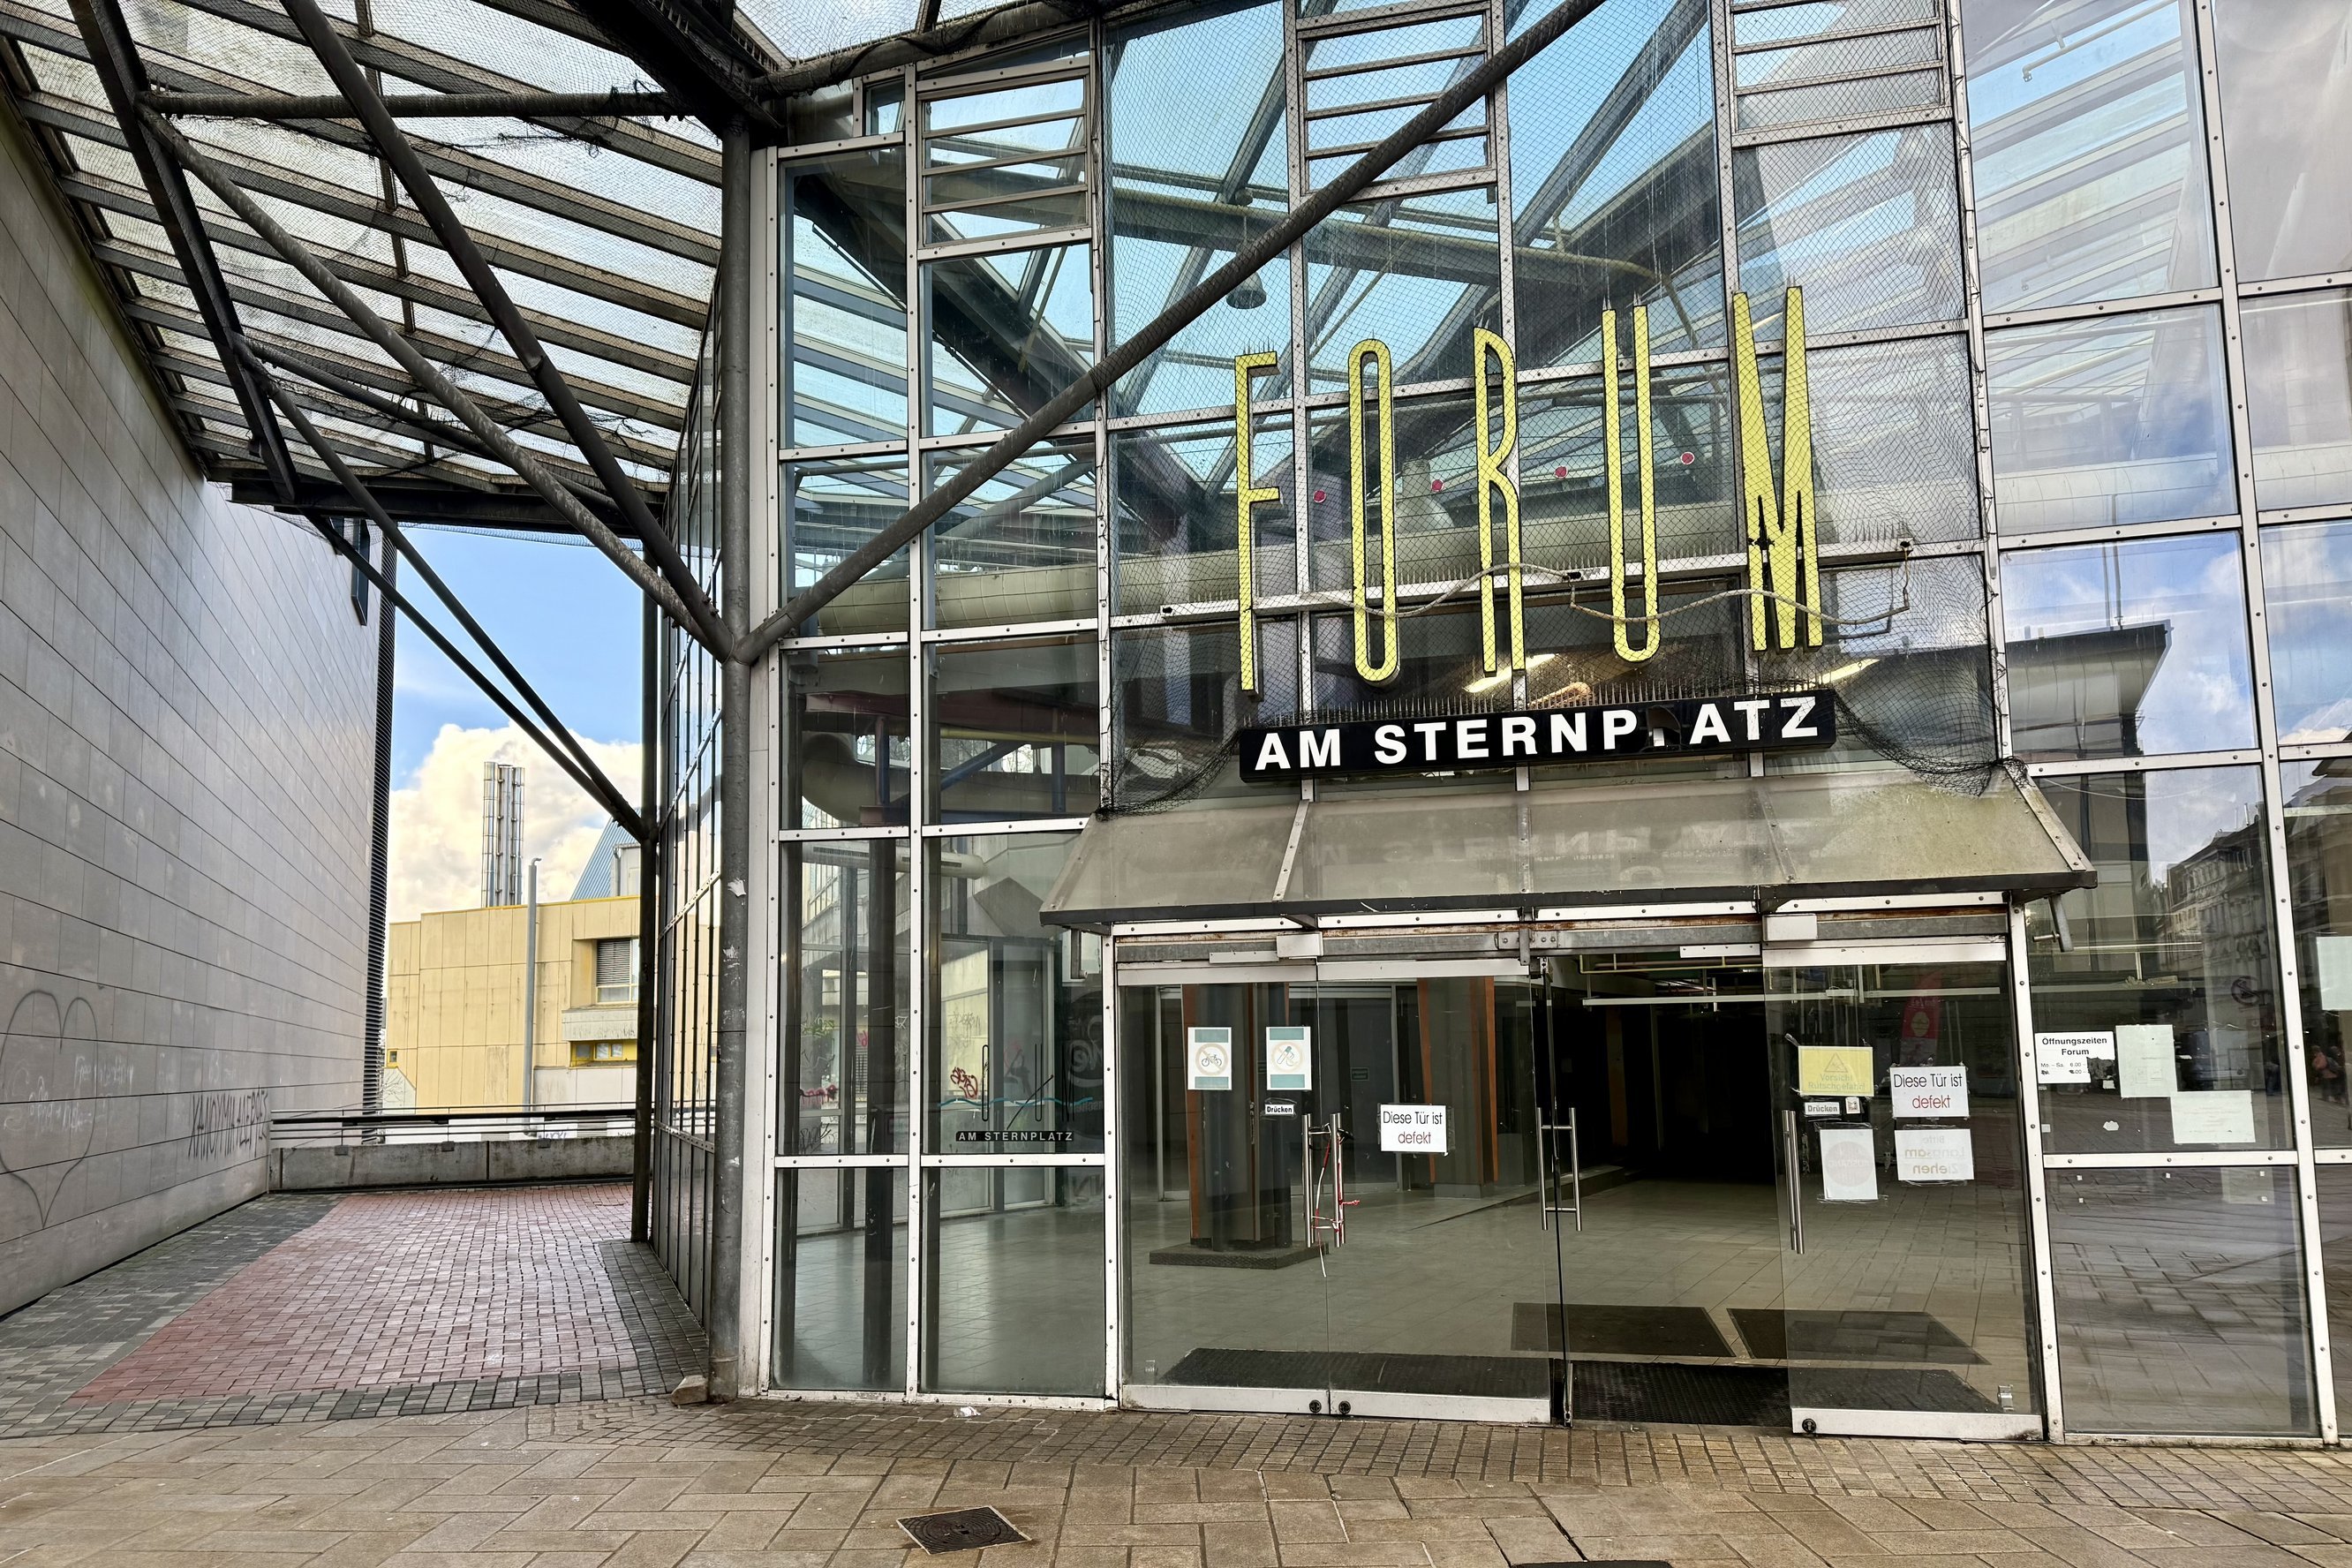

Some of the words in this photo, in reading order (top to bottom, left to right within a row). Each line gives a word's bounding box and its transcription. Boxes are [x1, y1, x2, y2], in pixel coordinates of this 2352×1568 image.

[1235, 286, 1823, 692] FORUM
[1255, 729, 1341, 771] AM
[1374, 697, 1819, 764] STERNPATZ
[2041, 1037, 2107, 1046] Öffnungszeiten
[1894, 1074, 1927, 1088] Diese
[1930, 1073, 1949, 1087] Tür
[1950, 1073, 1963, 1087] ist
[1266, 1104, 1293, 1114] Drücken
[1807, 1103, 1838, 1112] Drücken
[1911, 1095, 1951, 1109] defekt
[1383, 1111, 1413, 1125] Diese
[1414, 1110, 1430, 1125] Tür
[1432, 1110, 1443, 1125] ist
[959, 1132, 976, 1141] AM
[984, 1132, 1073, 1141] STERNPLATZ
[1398, 1131, 1431, 1145] defekt
